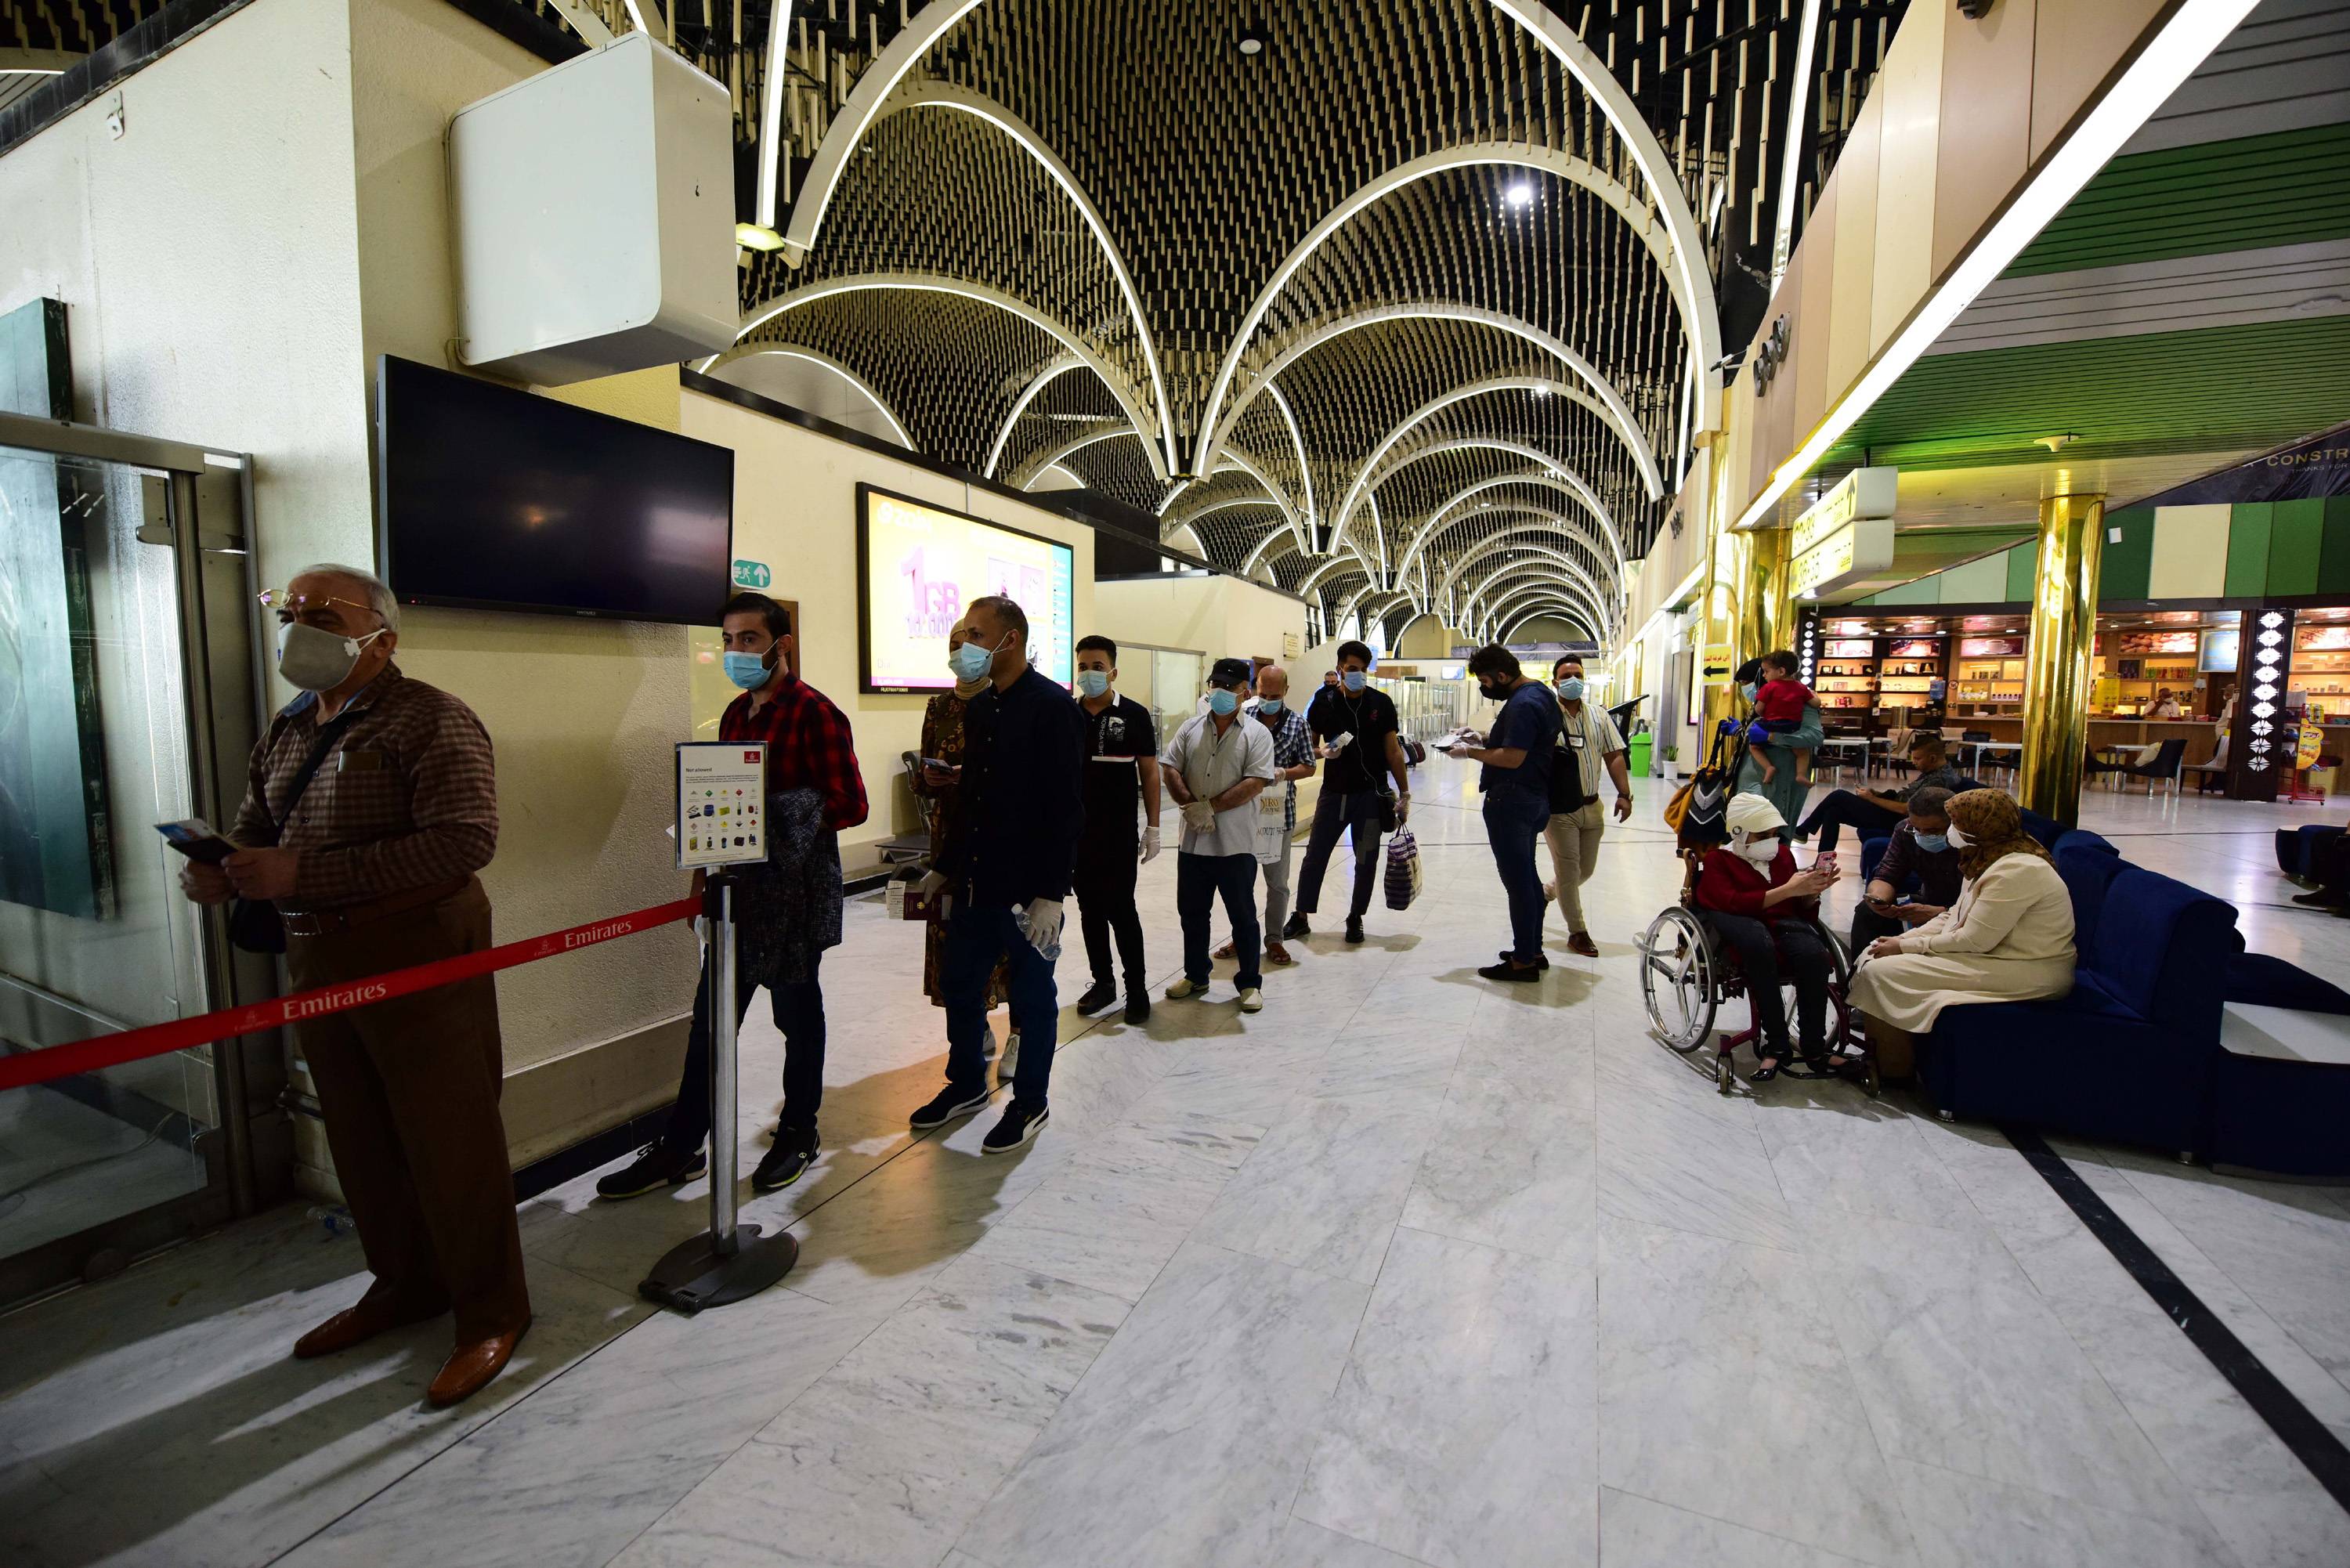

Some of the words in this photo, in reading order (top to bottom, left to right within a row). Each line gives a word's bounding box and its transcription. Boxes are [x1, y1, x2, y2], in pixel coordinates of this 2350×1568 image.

[2267, 447, 2349, 467] CONSTR
[2292, 464, 2324, 474] THANKS
[565, 919, 632, 948] Emirates
[283, 981, 387, 1020] Emirates
